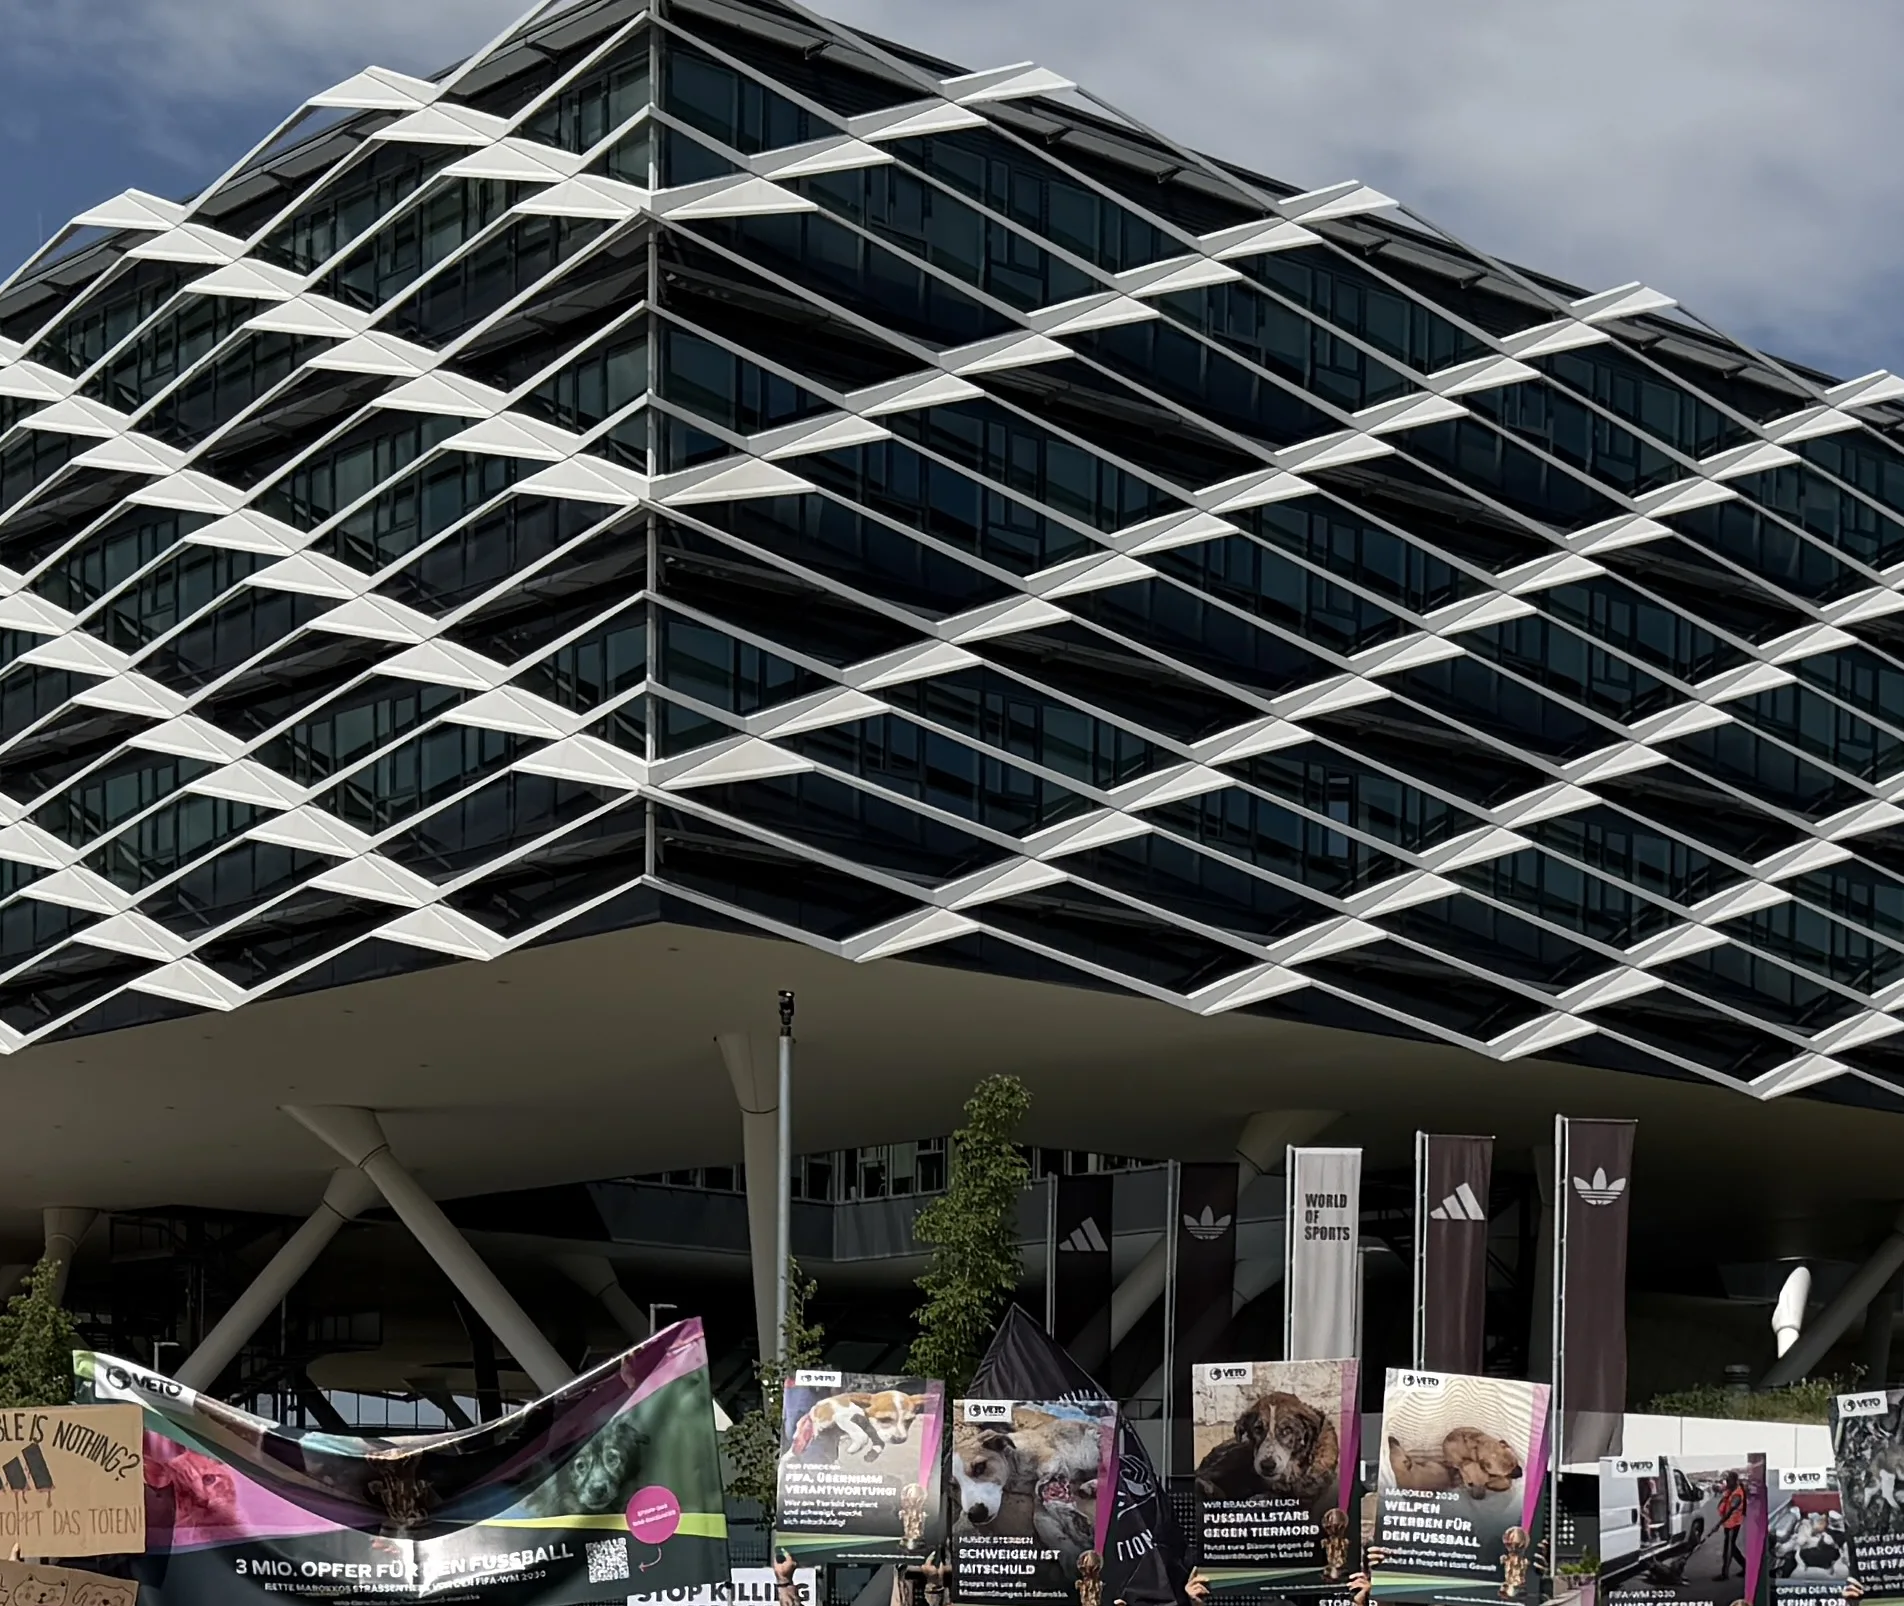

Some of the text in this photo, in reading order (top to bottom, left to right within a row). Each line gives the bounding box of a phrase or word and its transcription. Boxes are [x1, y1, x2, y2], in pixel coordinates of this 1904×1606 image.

[1305, 1193, 1347, 1208] WORLD
[1305, 1210, 1319, 1224] OF
[1304, 1226, 1350, 1240] SPORTS
[132, 1371, 183, 1397] VETO
[29, 1413, 49, 1443] IS
[53, 1419, 141, 1482] NOTHING?
[785, 1485, 897, 1496] VERANTWORTUNG!
[1385, 1501, 1440, 1513] WELPEN
[53, 1509, 81, 1536] DAS
[1203, 1511, 1310, 1524] FUSSBALLSTARS
[1383, 1515, 1472, 1531] STERBEN FÜR
[1203, 1525, 1320, 1538] GEGEN TIERMORD
[1382, 1530, 1481, 1547] DEN FUSSBALL
[236, 1558, 247, 1575] 3
[252, 1559, 298, 1578] MIO.
[301, 1561, 372, 1578] OPFER
[469, 1542, 574, 1572] FUSSBALL
[958, 1548, 1061, 1561] SCHWEIGEN IST
[959, 1564, 1036, 1575] MITSCHULD
[1858, 1560, 1878, 1571] DIE
[711, 1583, 810, 1601] KILLIG
